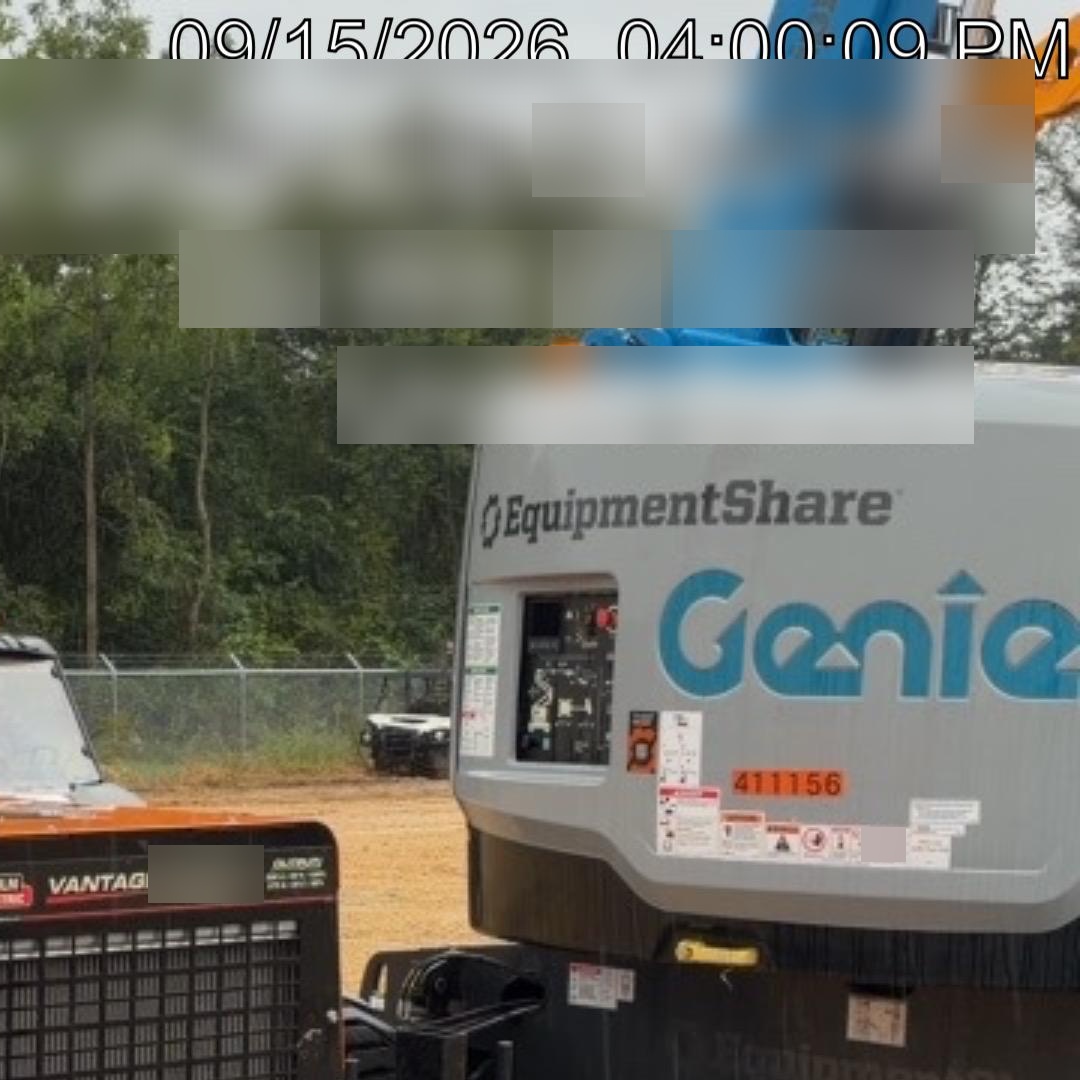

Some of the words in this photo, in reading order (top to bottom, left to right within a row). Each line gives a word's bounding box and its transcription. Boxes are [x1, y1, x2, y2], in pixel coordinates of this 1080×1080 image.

[502, 479, 893, 543] EquipmentShare
[657, 567, 1080, 700] Genie
[733, 771, 843, 796] 411156
[49, 872, 148, 894] VANTAG
